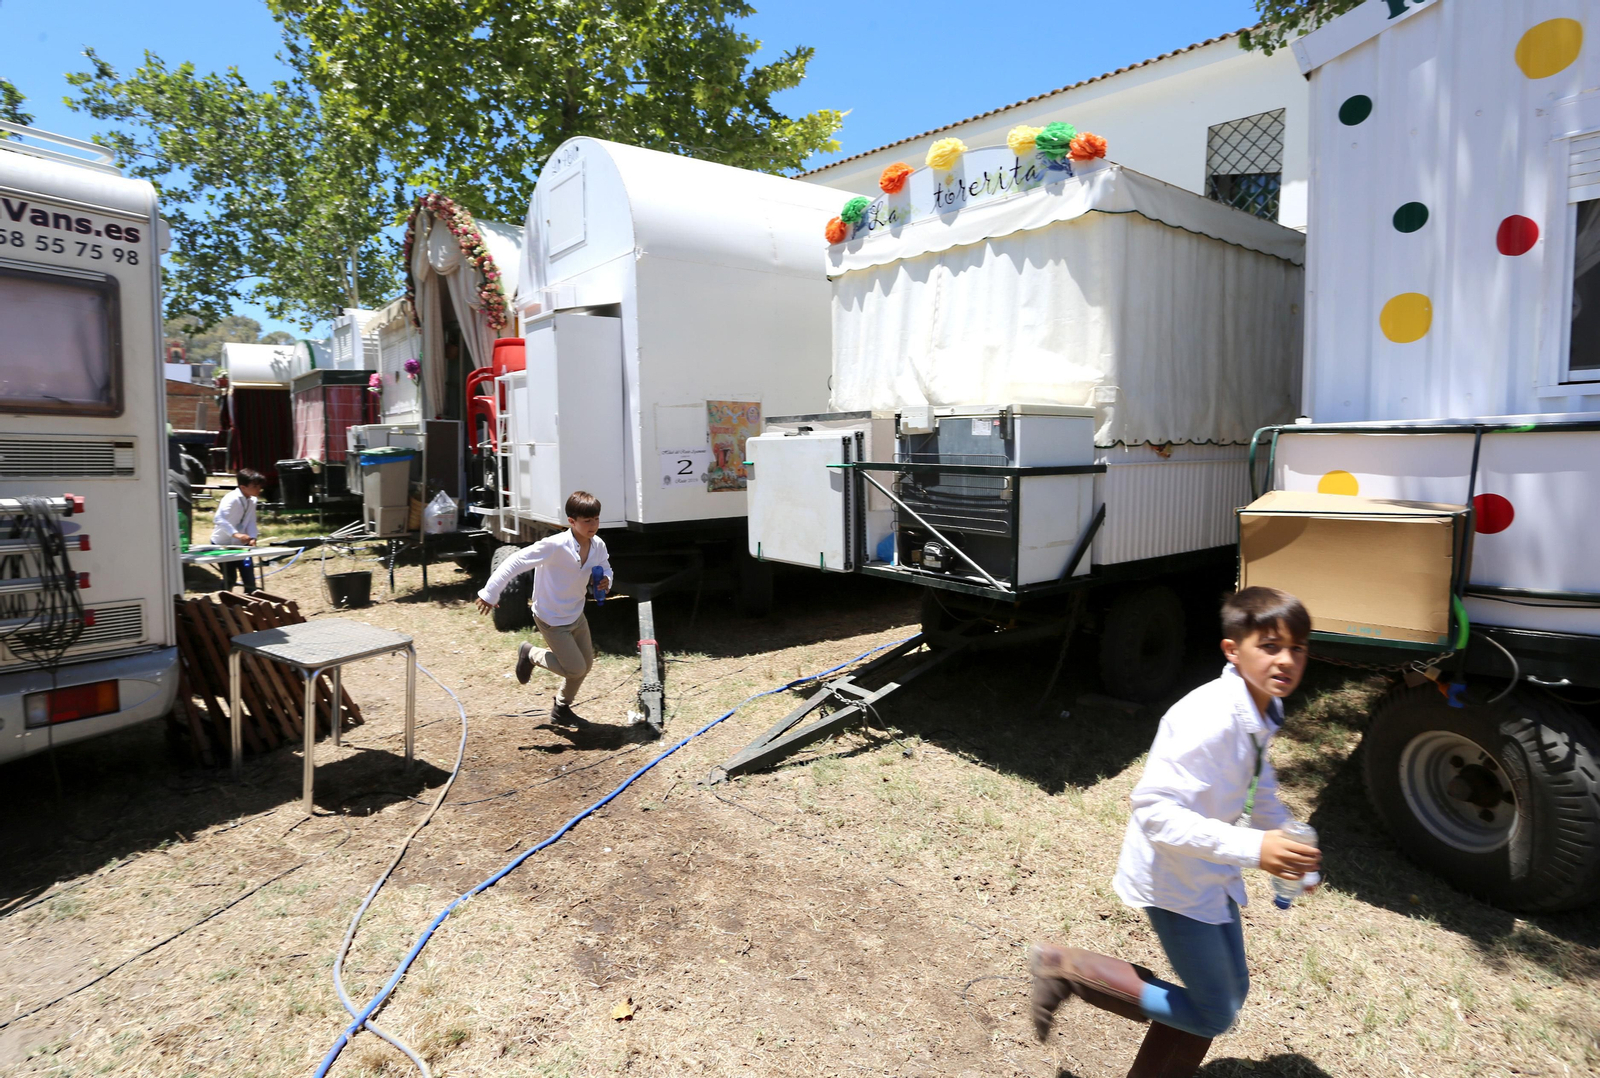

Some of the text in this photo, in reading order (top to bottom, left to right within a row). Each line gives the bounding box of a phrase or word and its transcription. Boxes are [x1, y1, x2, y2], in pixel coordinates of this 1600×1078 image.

[930, 157, 1040, 214] torerita
[0, 198, 141, 243] Vans.es
[35, 235, 65, 254] 55
[75, 241, 104, 260] 75
[113, 248, 139, 265] 98
[677, 459, 693, 475] 2
